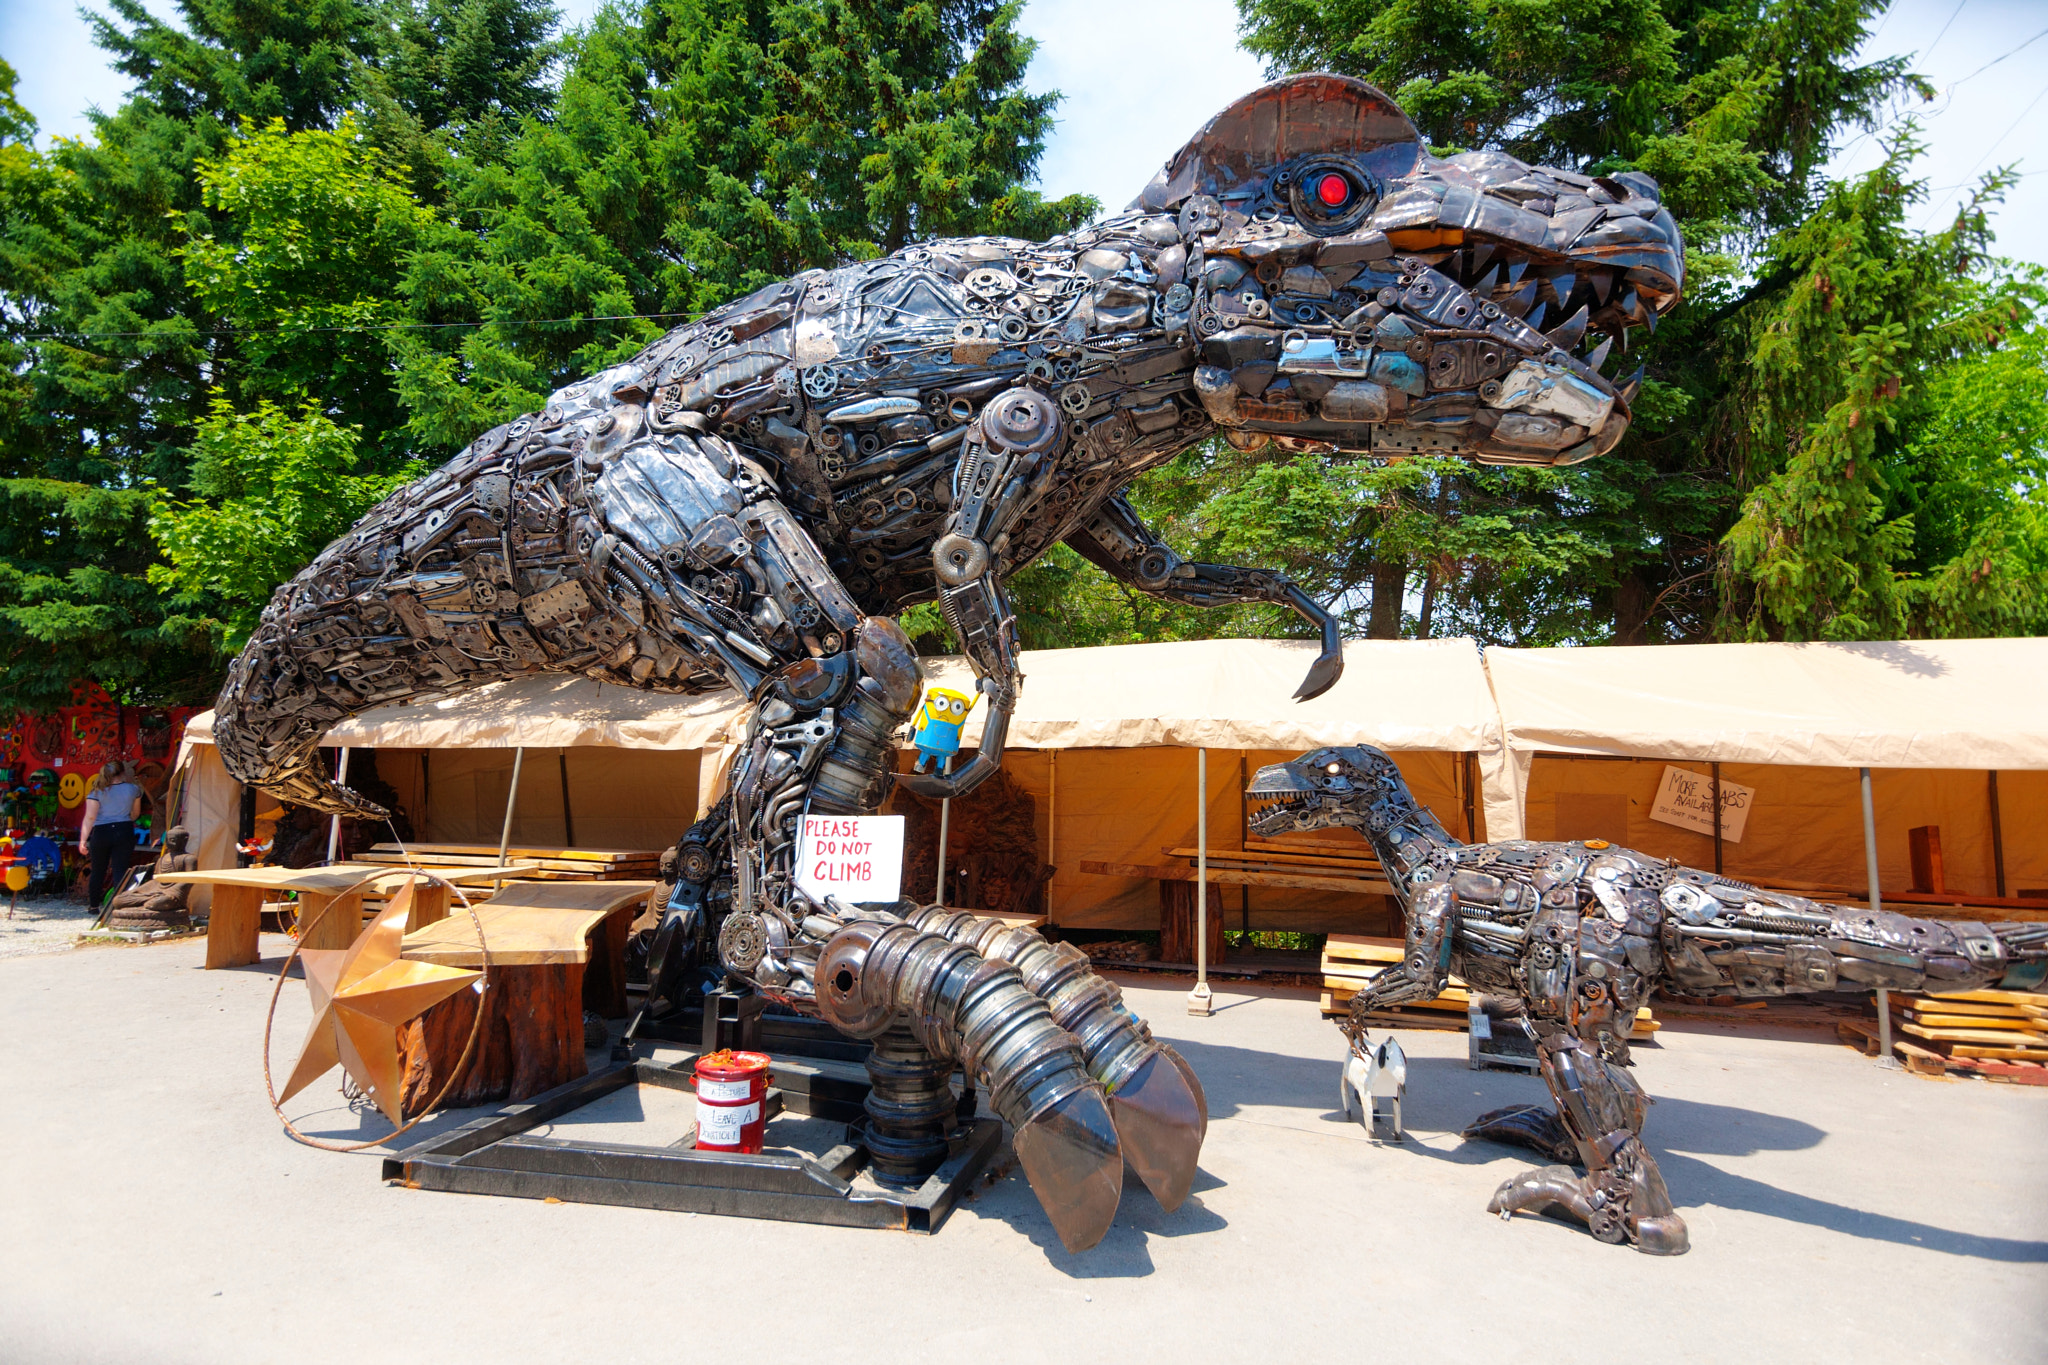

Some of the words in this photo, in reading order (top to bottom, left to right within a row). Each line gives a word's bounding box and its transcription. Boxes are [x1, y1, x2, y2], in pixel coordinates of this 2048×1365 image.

[1668, 772, 1698, 797] MORE
[1702, 781, 1748, 809] SABS
[806, 820, 859, 838] PLEASE
[816, 840, 836, 856] DO
[841, 841, 872, 855] NOT
[813, 860, 872, 882] CLIMB
[712, 1109, 737, 1125] LEAVE
[743, 1109, 752, 1122] A
